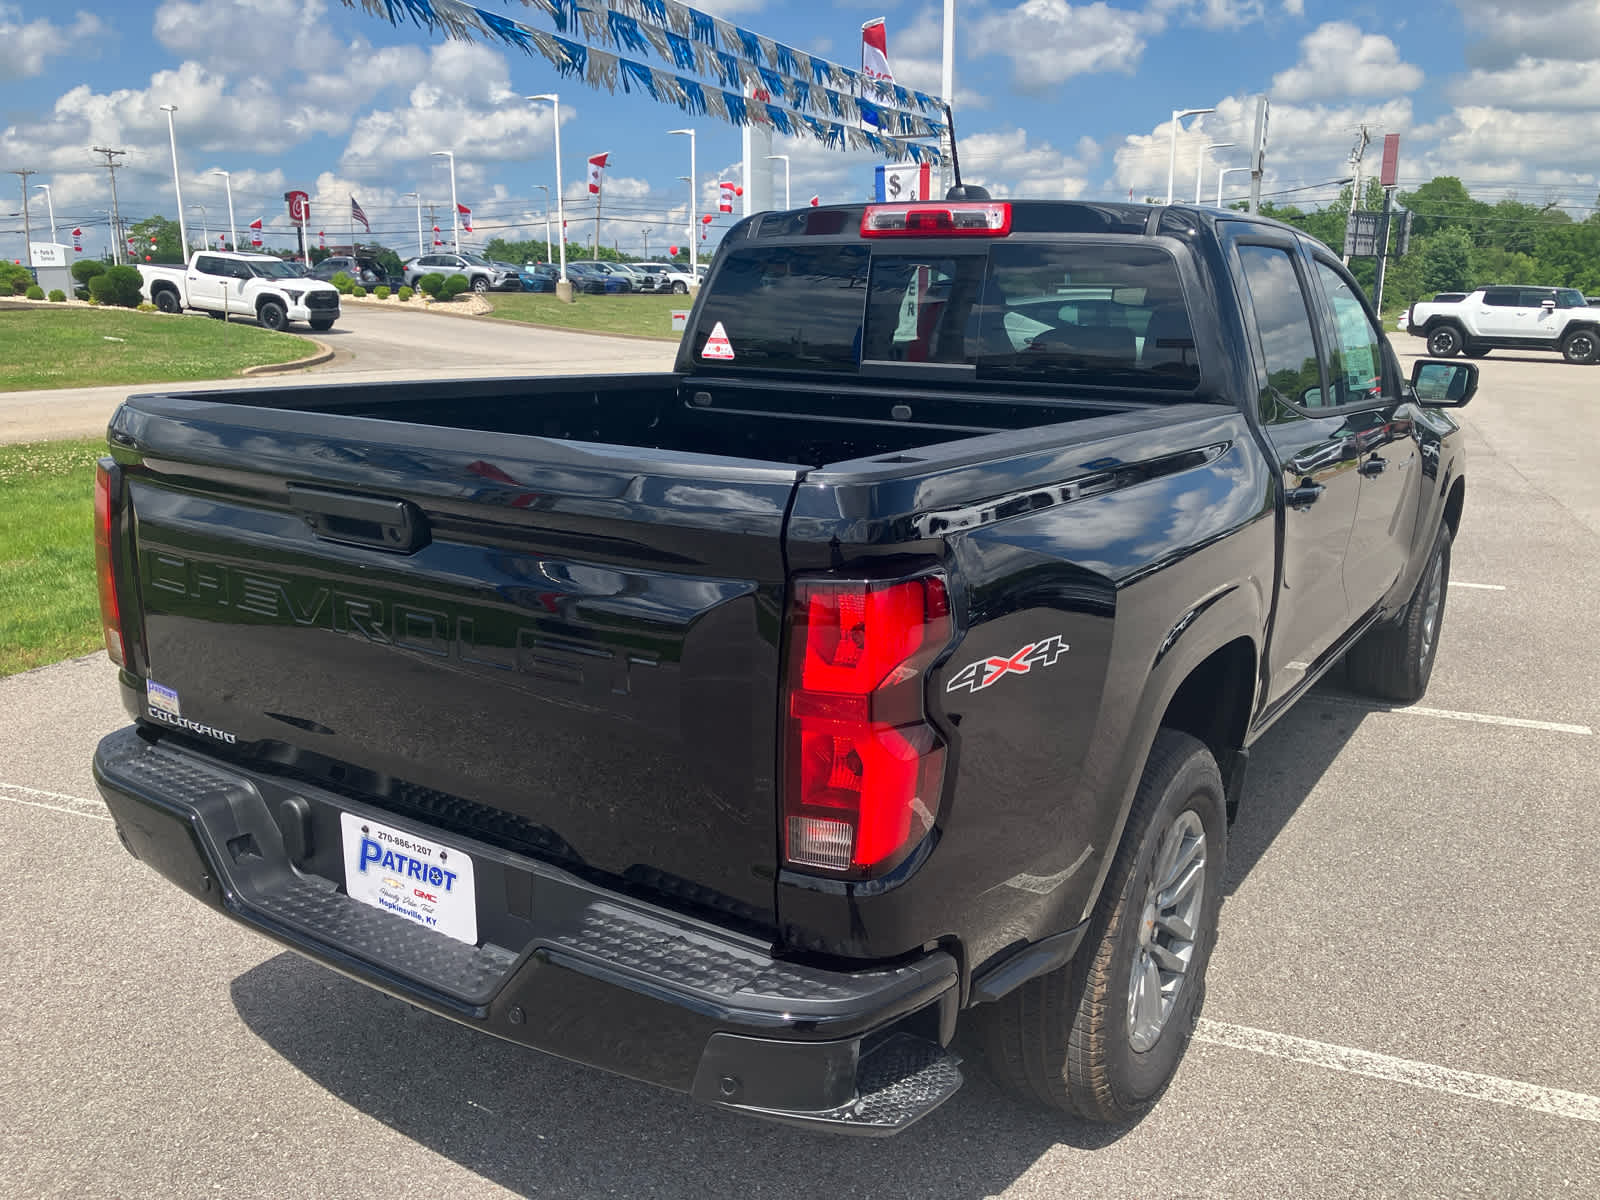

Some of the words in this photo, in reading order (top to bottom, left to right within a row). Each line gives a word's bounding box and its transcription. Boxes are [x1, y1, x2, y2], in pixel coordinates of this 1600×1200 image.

[149, 551, 661, 695] CHEVROLET
[147, 706, 237, 744] COLORADO
[377, 831, 432, 857] 270-886-1207
[359, 837, 457, 891] PATRIOT
[378, 897, 424, 923] Hopkinsville,
[426, 915, 437, 926] KY
[413, 888, 438, 903] GMC
